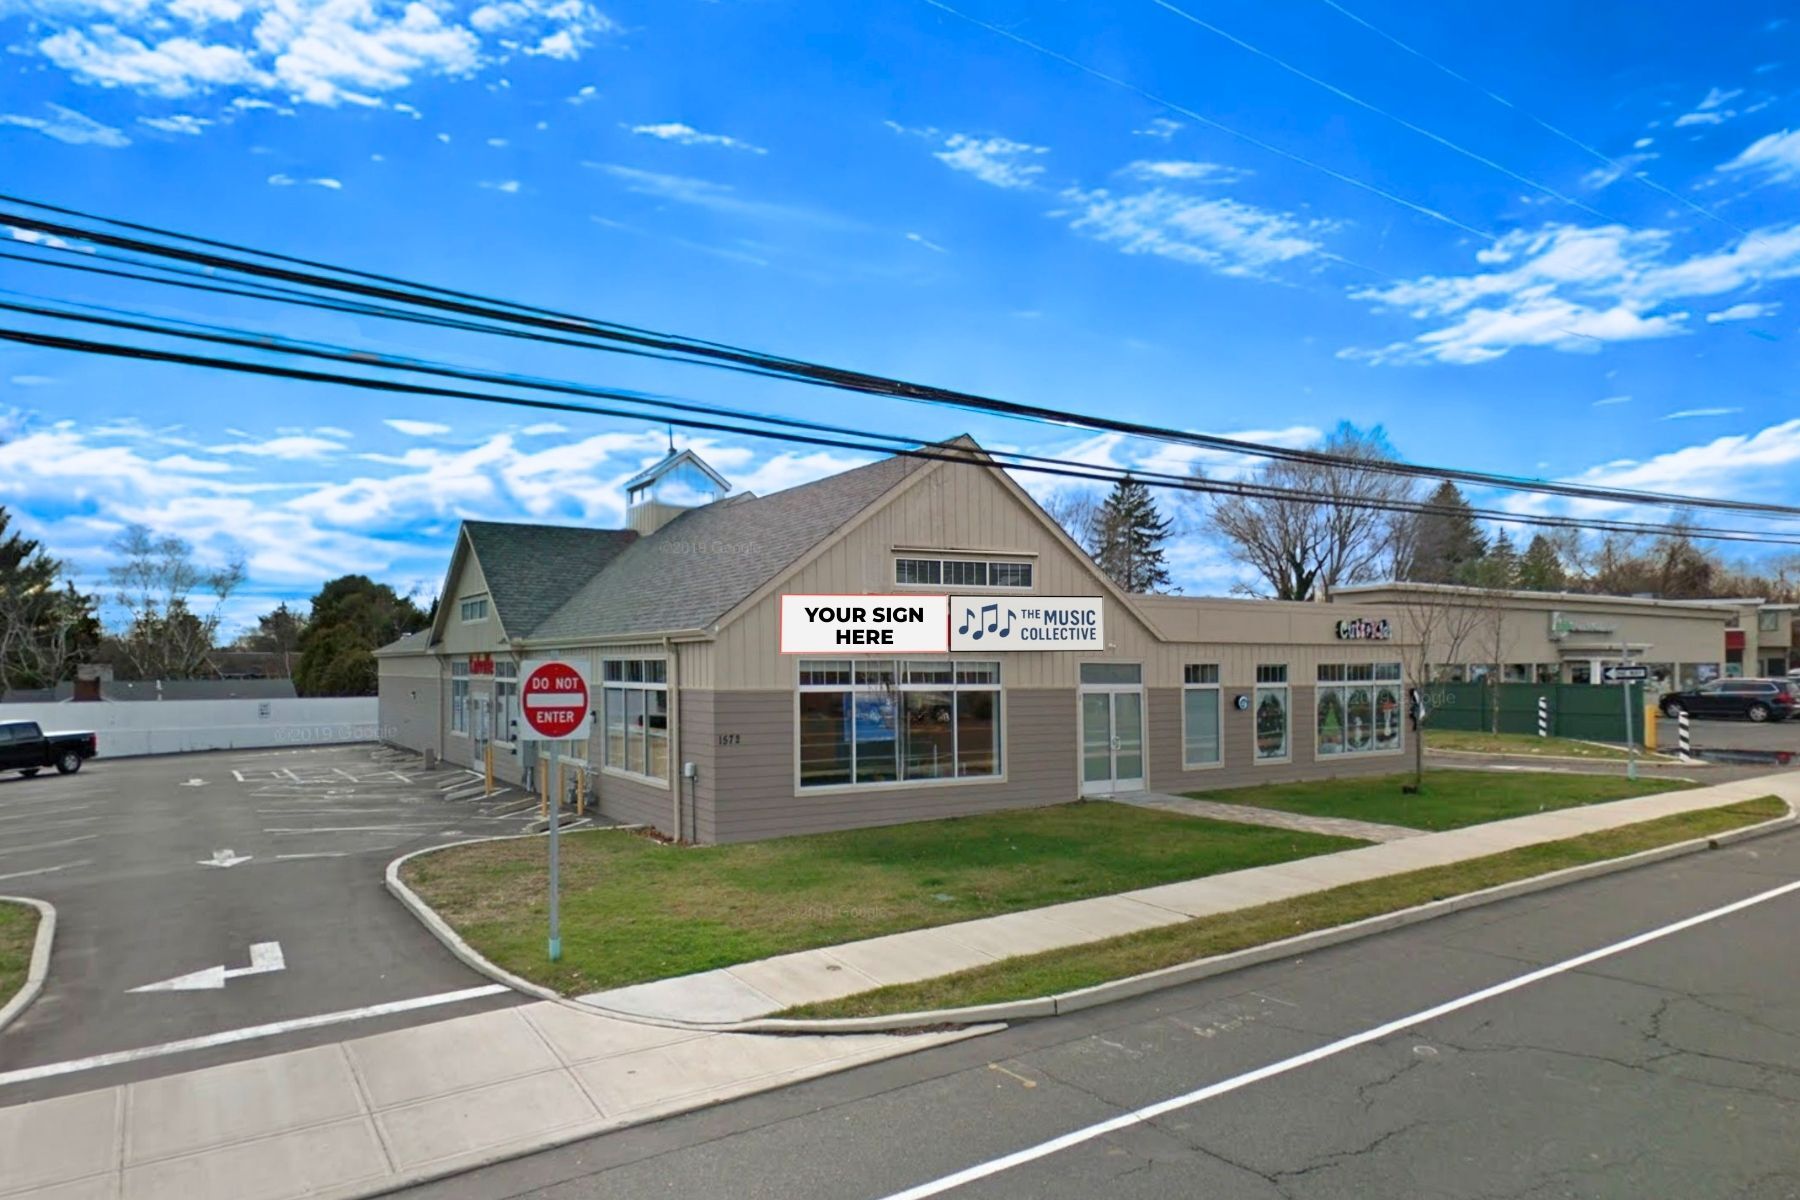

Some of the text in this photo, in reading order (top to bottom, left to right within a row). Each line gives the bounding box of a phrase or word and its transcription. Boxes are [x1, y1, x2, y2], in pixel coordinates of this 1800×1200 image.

[804, 607, 924, 623] YOUR SIGN
[1020, 609, 1097, 626] THE MUSIC
[835, 629, 894, 645] HERE
[1020, 628, 1097, 641] COLLECTIVE
[532, 677, 579, 690] DO NOT
[536, 711, 575, 724] ENTER
